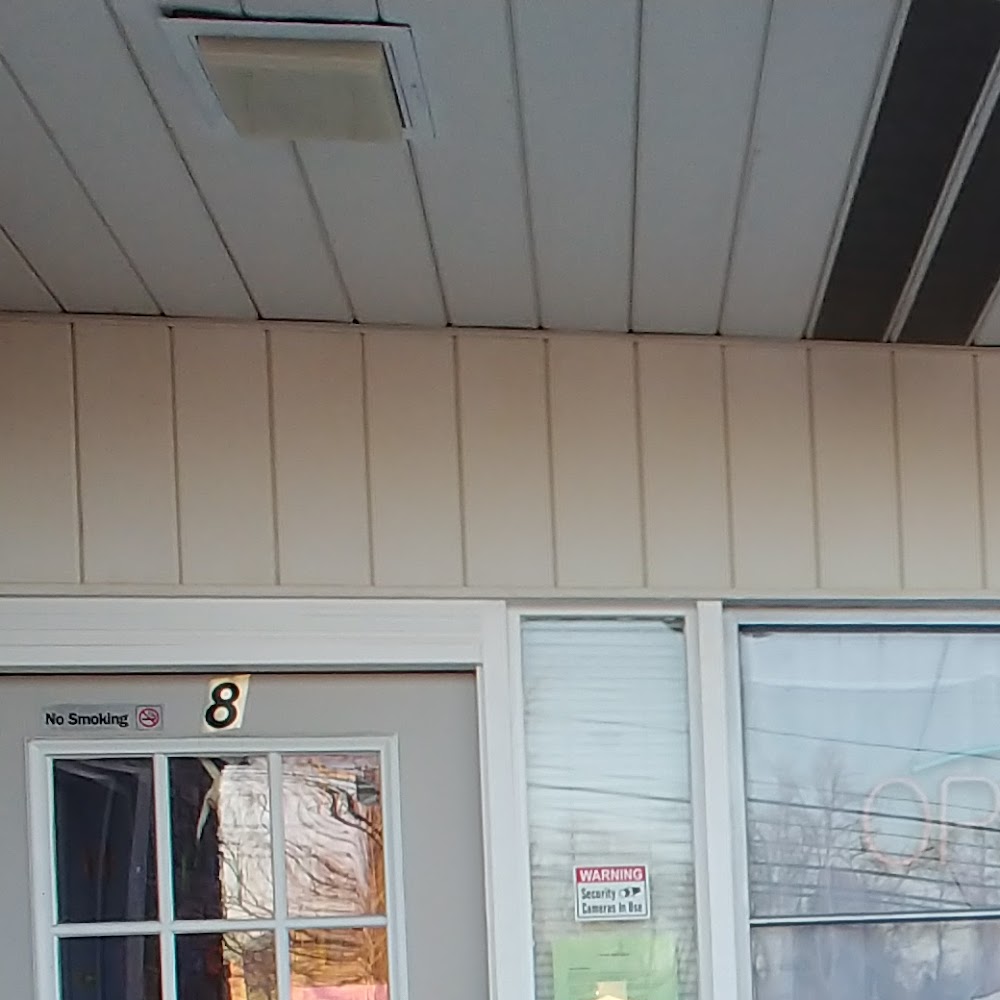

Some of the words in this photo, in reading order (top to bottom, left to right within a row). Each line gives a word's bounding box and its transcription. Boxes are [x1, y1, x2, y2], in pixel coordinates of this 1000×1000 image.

[204, 682, 240, 729] 8
[45, 712, 65, 726] No
[68, 711, 130, 728] Smoking
[579, 868, 643, 882] WARNING
[581, 888, 616, 901] Security
[582, 903, 616, 914] Cameras
[628, 901, 643, 913] Use
